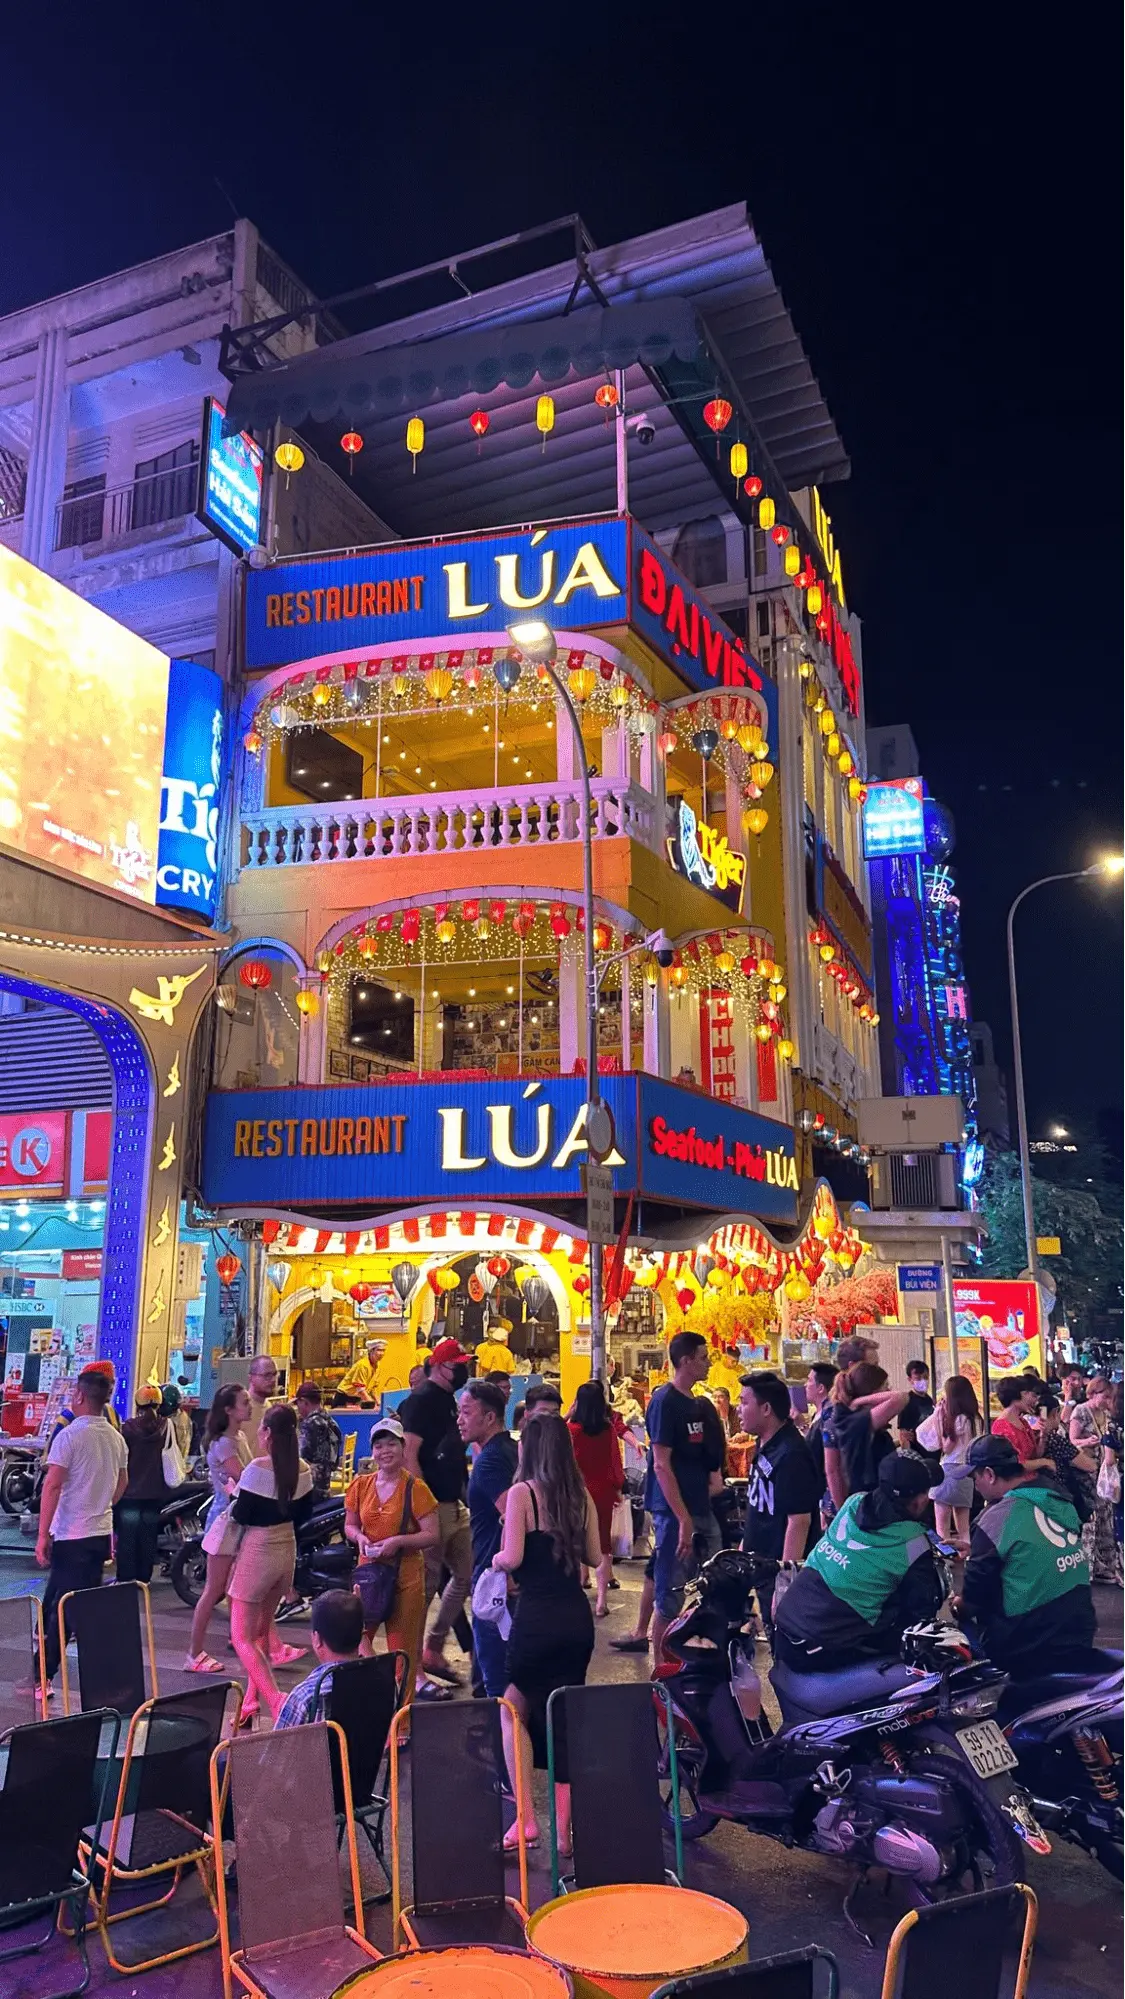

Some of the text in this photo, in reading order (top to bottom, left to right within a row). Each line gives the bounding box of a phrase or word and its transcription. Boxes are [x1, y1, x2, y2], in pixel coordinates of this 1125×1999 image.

[267, 530, 620, 627] RESTAURANT LÚA
[698, 820, 743, 890] Tiger
[234, 1083, 626, 1170] RESTAURANT LÚA
[653, 1116, 724, 1170] Seafood
[766, 1146, 799, 1191] LÚA
[818, 1541, 851, 1570] gojek
[877, 1707, 937, 1735] mobifone
[964, 1725, 998, 1751] 59-T1
